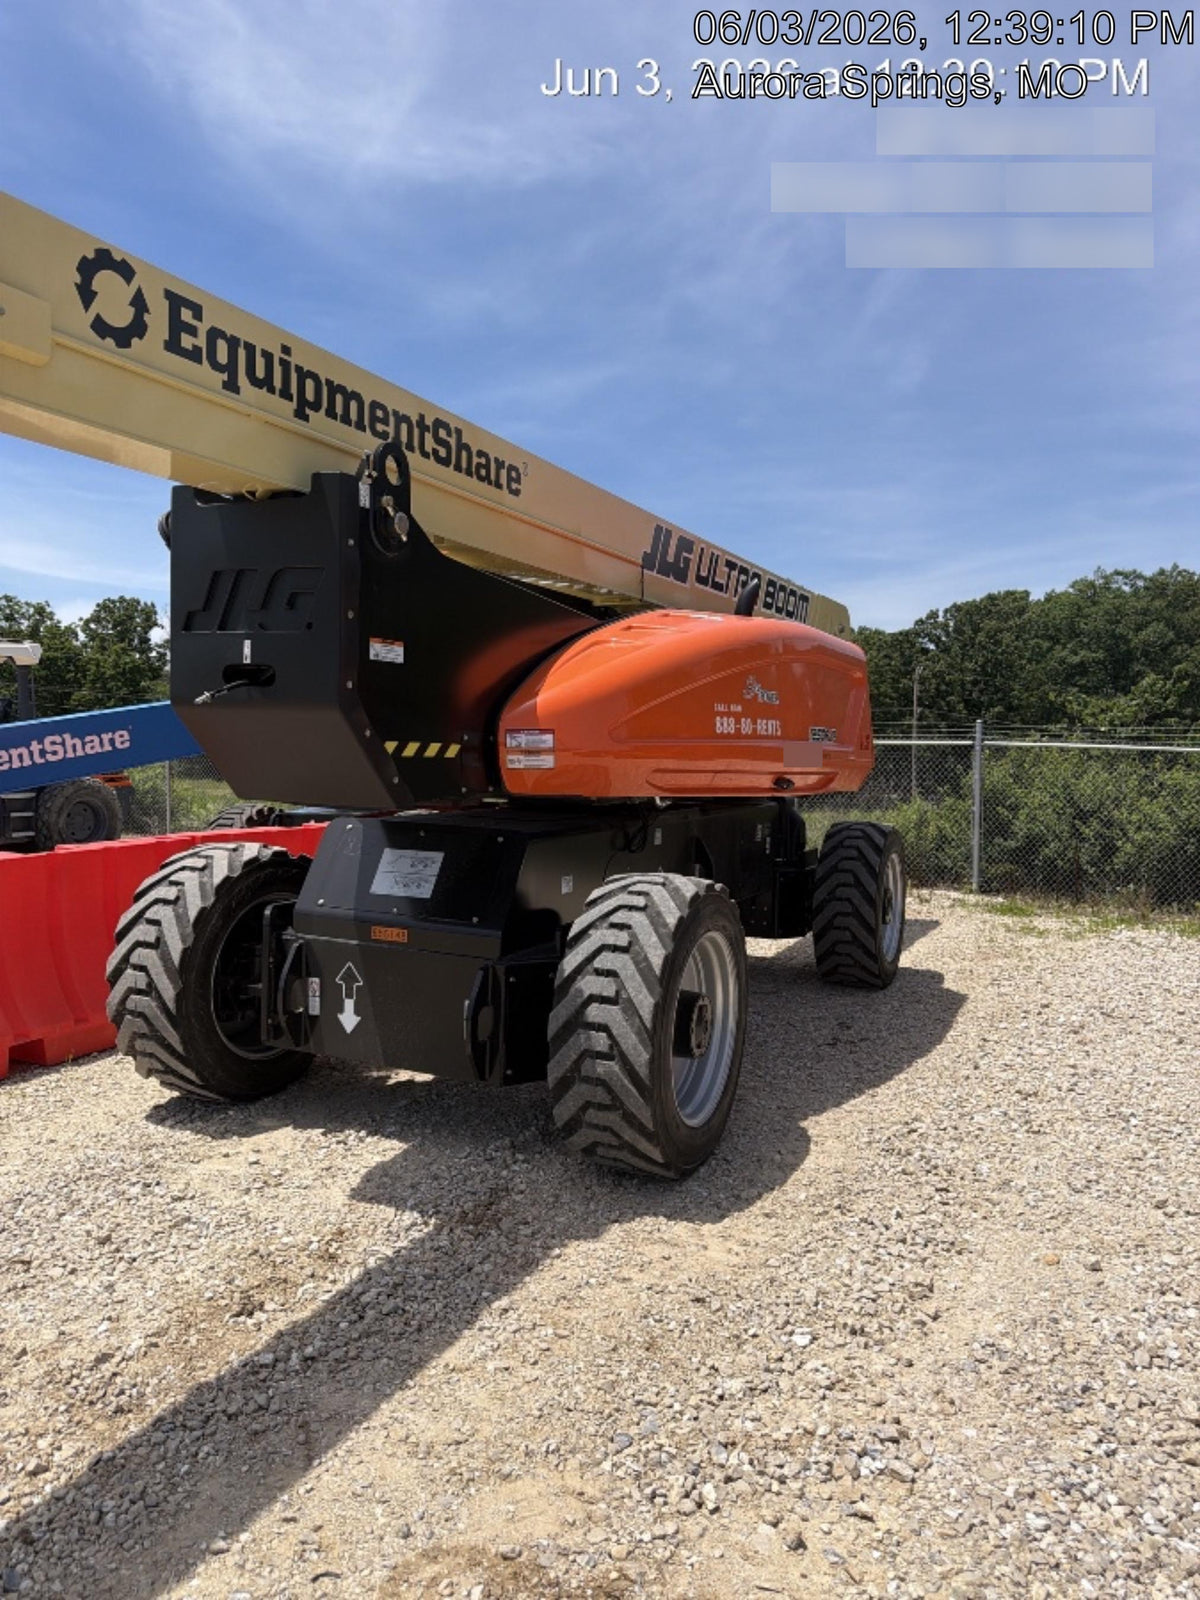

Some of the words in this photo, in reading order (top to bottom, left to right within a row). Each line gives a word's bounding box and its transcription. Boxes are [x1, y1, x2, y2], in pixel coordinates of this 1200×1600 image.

[163, 288, 522, 497] EquipmentShare
[642, 524, 694, 584] JLG
[762, 577, 810, 625] BOOM
[0, 729, 131, 771] entShare
